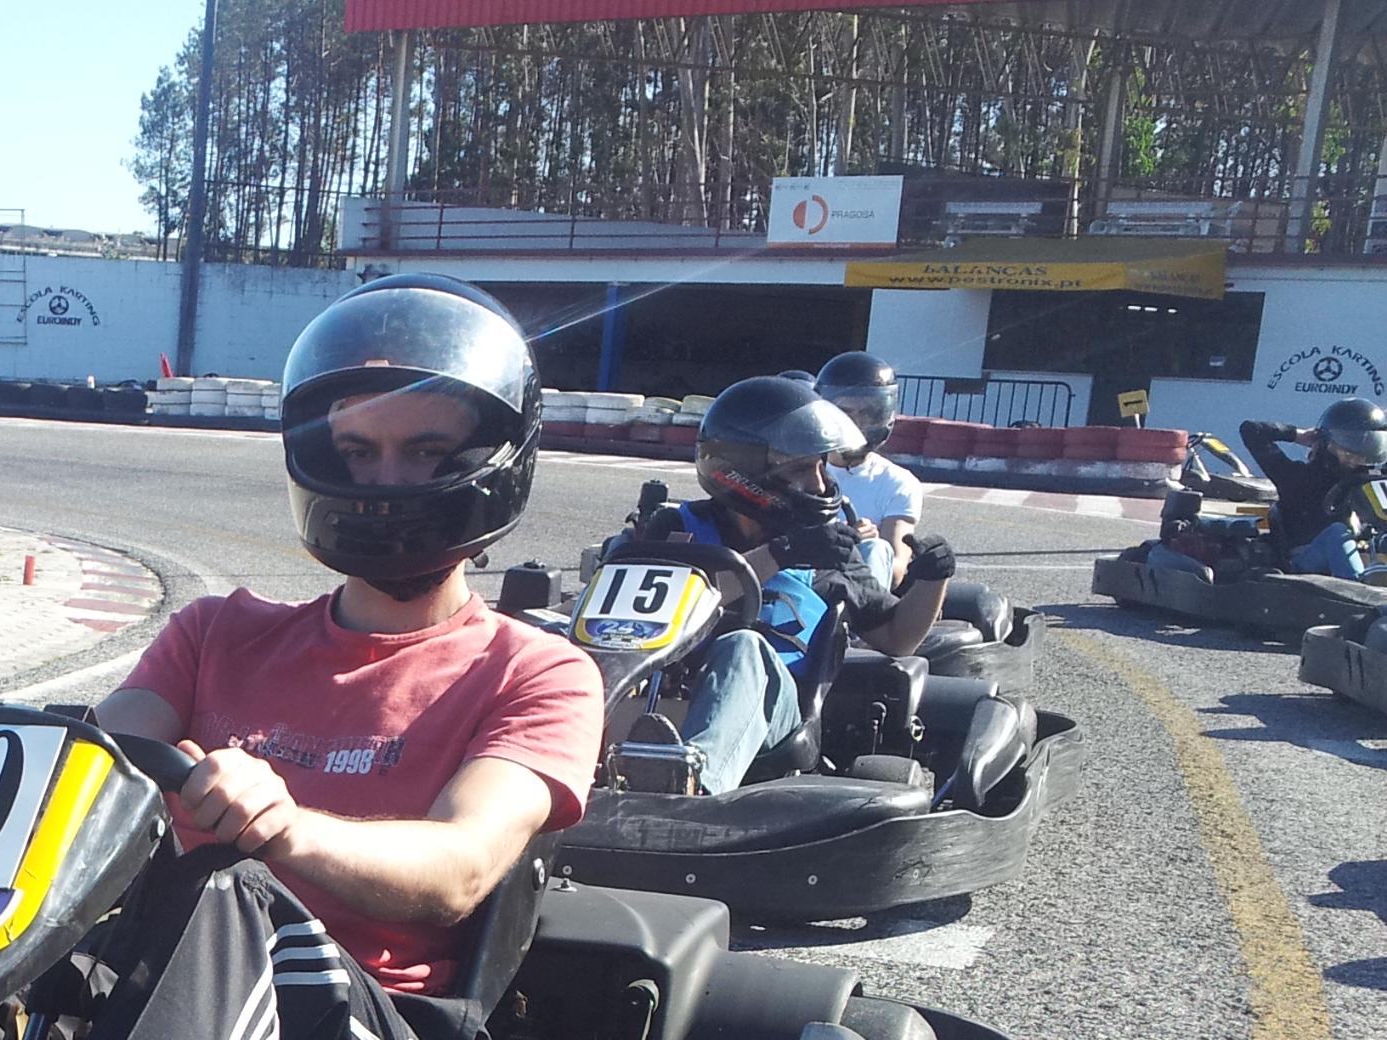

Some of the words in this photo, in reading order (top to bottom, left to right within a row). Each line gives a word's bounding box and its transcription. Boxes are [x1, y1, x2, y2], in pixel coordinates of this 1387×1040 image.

[59, 285, 101, 326] KARTING
[1267, 346, 1321, 390] ESCOLA
[1332, 344, 1384, 396] KARTING
[1295, 382, 1358, 394] EUROINDY
[599, 569, 673, 614] 15
[324, 749, 375, 774] 1998
